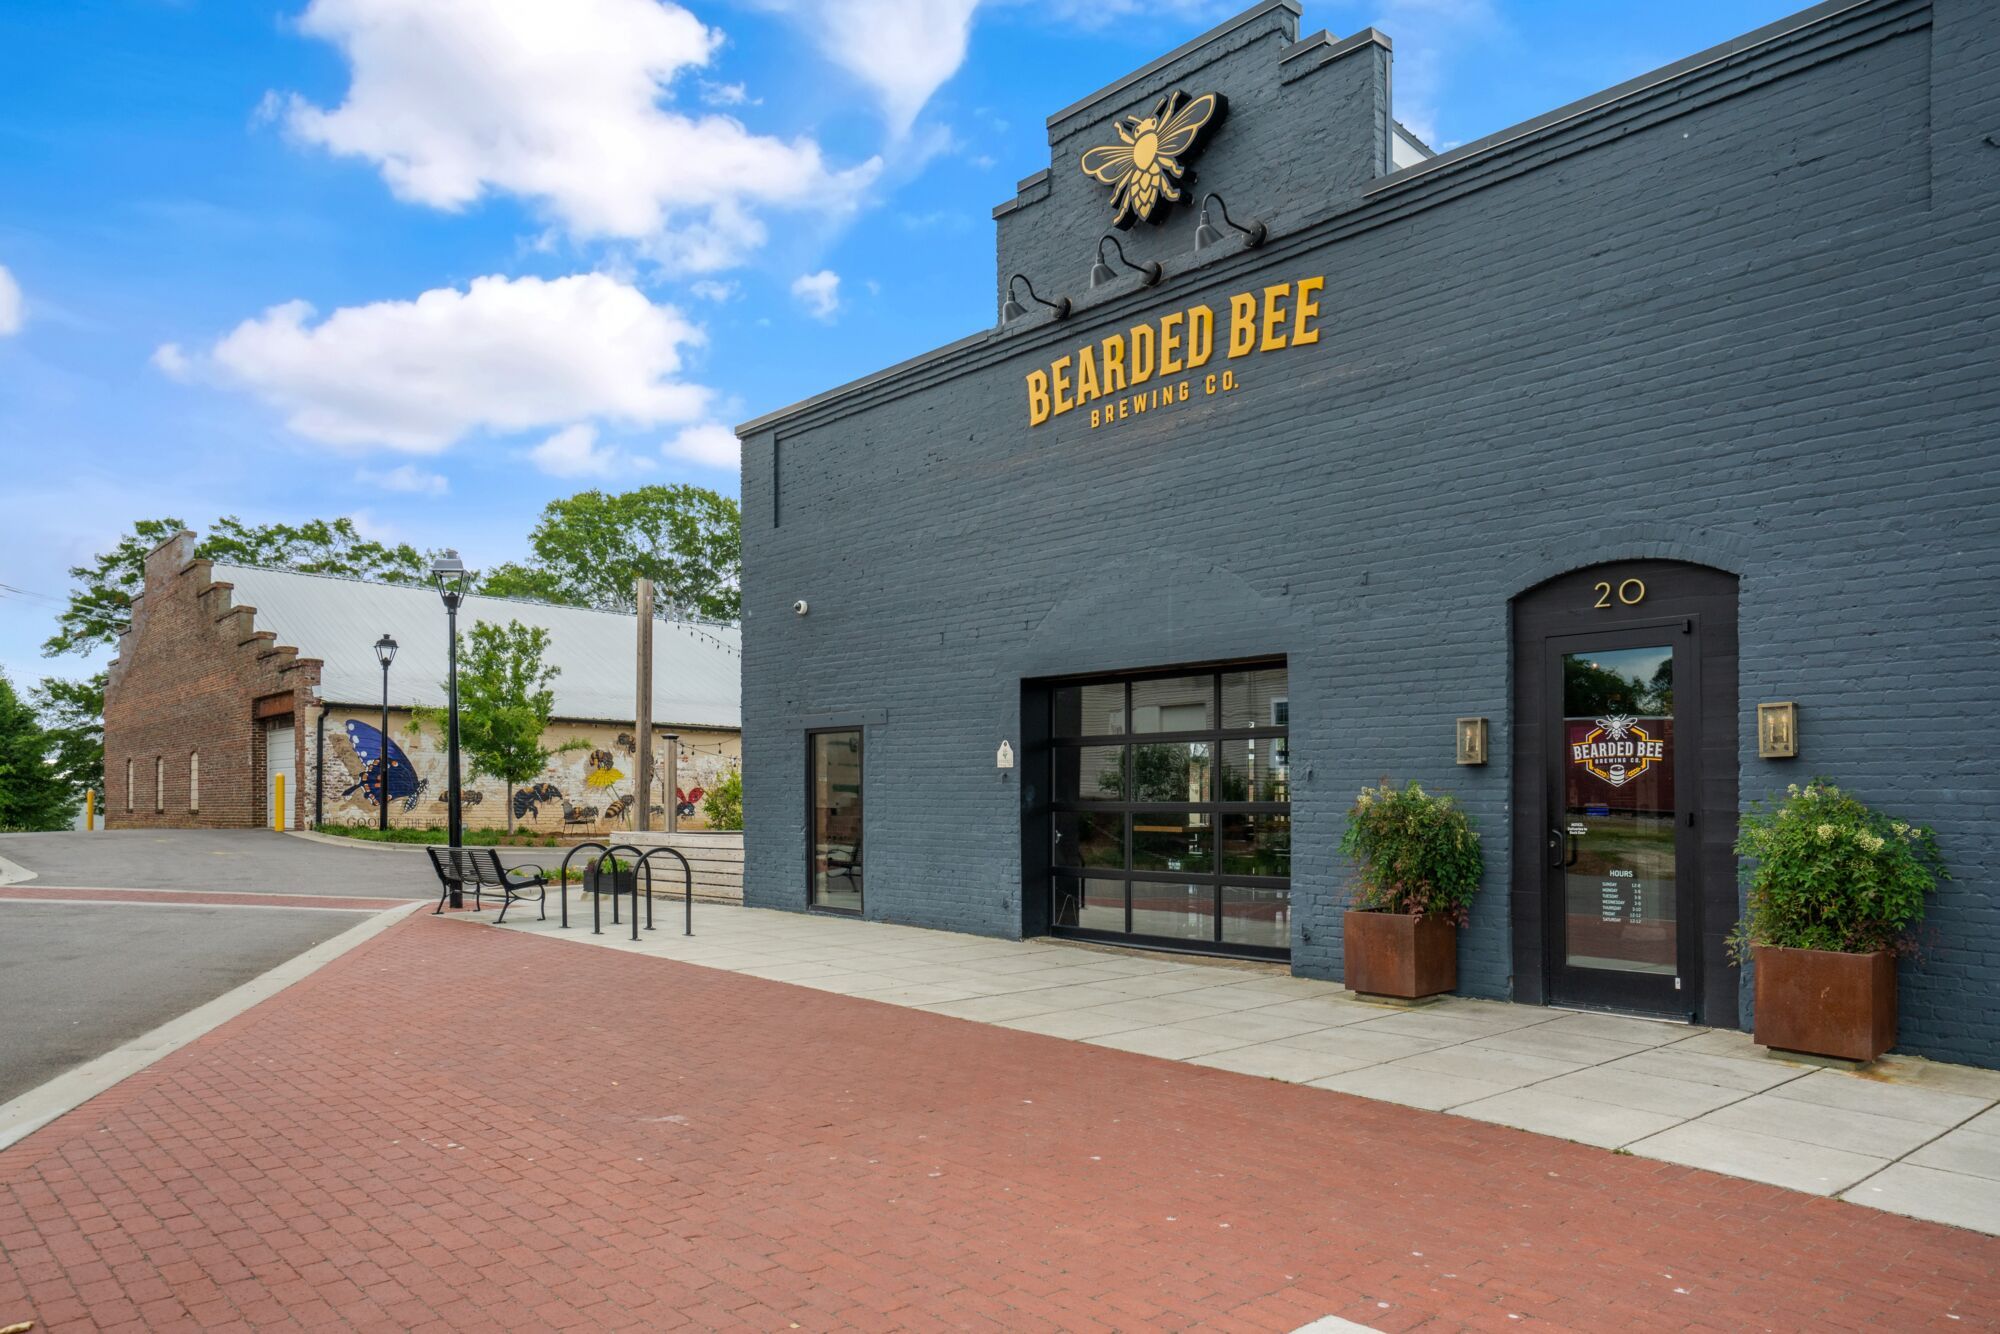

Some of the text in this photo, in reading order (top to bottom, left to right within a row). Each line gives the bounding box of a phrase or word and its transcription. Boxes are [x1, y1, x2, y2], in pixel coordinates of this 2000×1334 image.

[1025, 276, 1325, 427] BEARDED BEE
[1090, 370, 1239, 429] BREWING CO.
[1594, 578, 1645, 608] 20
[1573, 741, 1664, 760] BEARDED BEE
[1595, 757, 1627, 765] BREWING
[346, 816, 381, 828] GOO
[1609, 869, 1633, 878] HOURS
